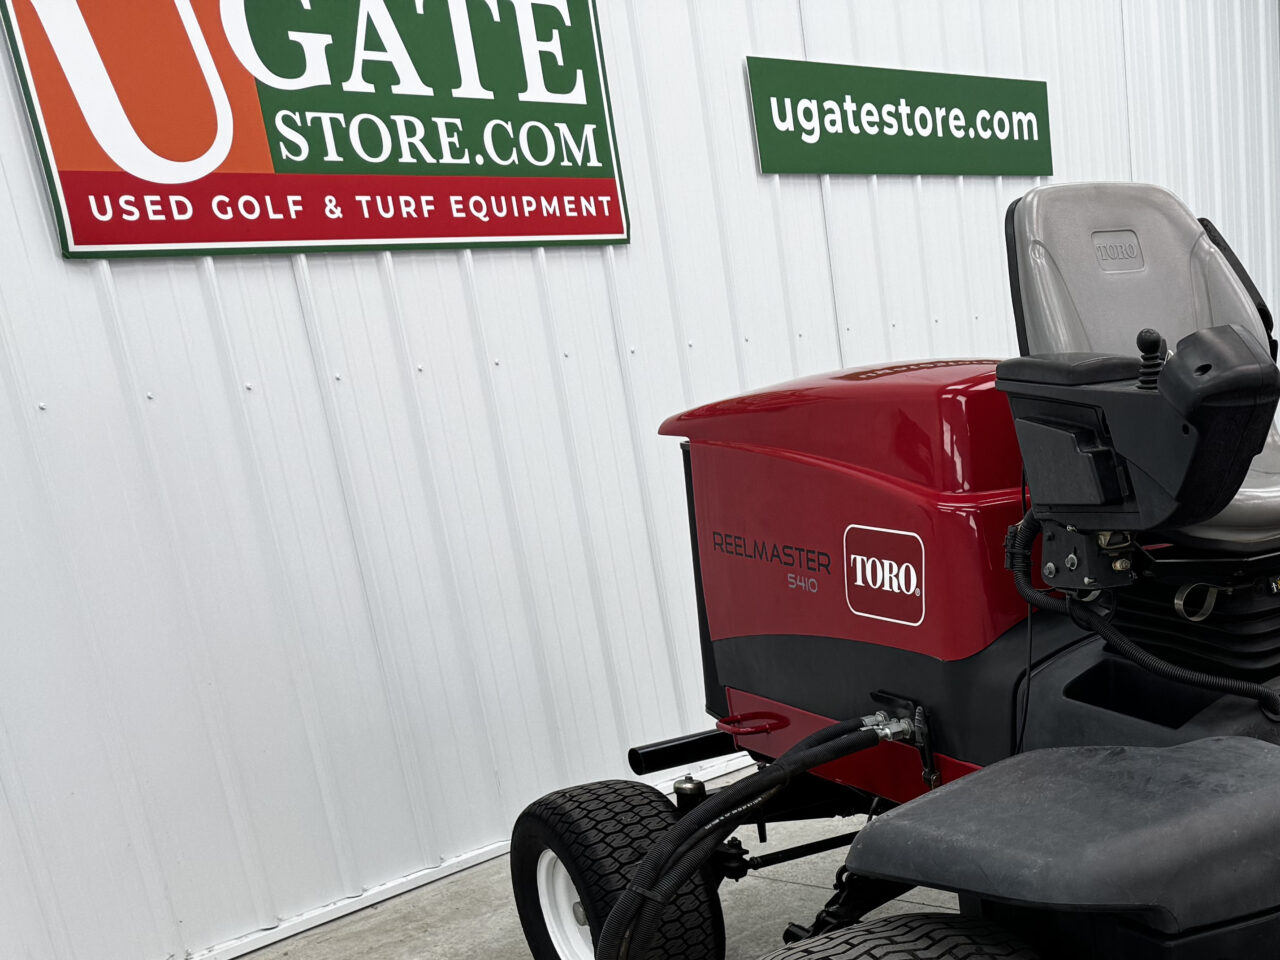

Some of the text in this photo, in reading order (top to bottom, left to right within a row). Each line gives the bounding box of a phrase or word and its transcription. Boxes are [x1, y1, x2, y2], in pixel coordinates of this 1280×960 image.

[769, 94, 1039, 144] ugatestore.com
[274, 109, 604, 168] STORE.COM
[88, 194, 612, 224] USED GOLF & TURF EQUIPMENT
[1096, 244, 1137, 261] TORO
[711, 531, 832, 575] REELMASTER
[787, 573, 819, 593] 5410
